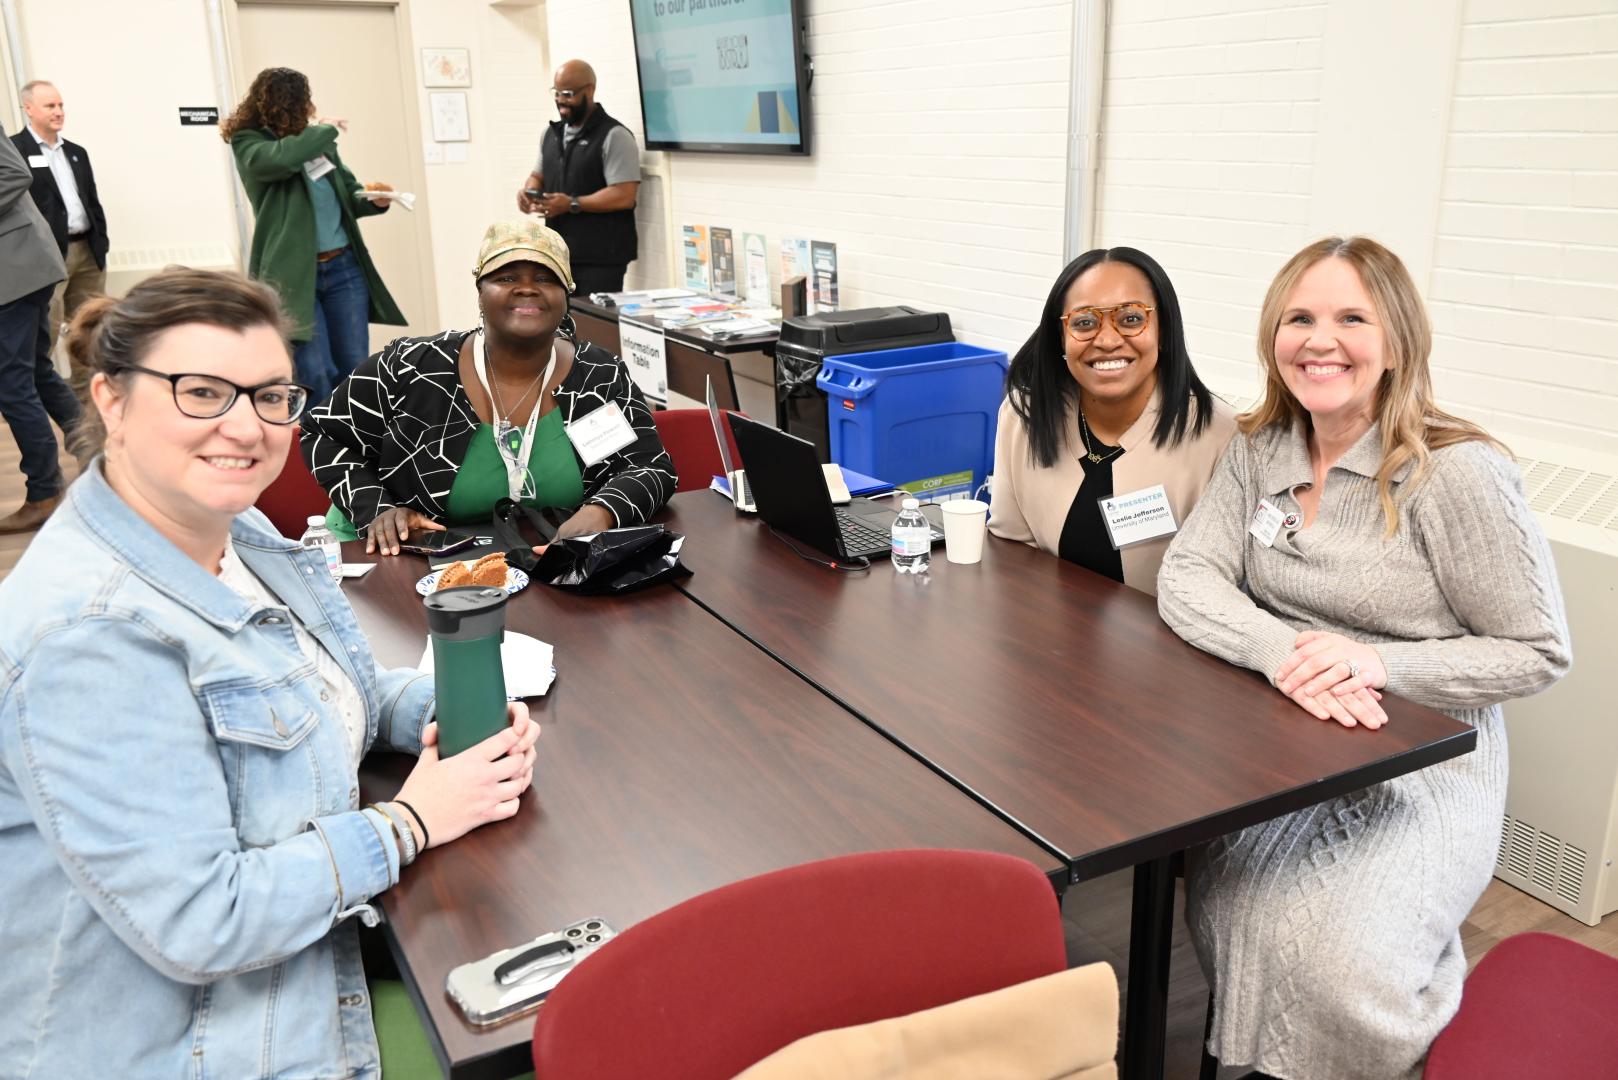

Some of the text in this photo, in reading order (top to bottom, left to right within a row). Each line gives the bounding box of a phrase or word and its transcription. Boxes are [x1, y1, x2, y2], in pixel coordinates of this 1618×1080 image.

[653, 0, 665, 17] to
[667, 0, 685, 15] our
[622, 335, 660, 359] Information
[632, 352, 650, 370] Table
[1118, 492, 1163, 509] PRESENTER
[1111, 520, 1138, 531] University
[1145, 511, 1169, 522] Maryland
[1112, 515, 1132, 524] Leslie
[1133, 506, 1165, 519] Jefferson
